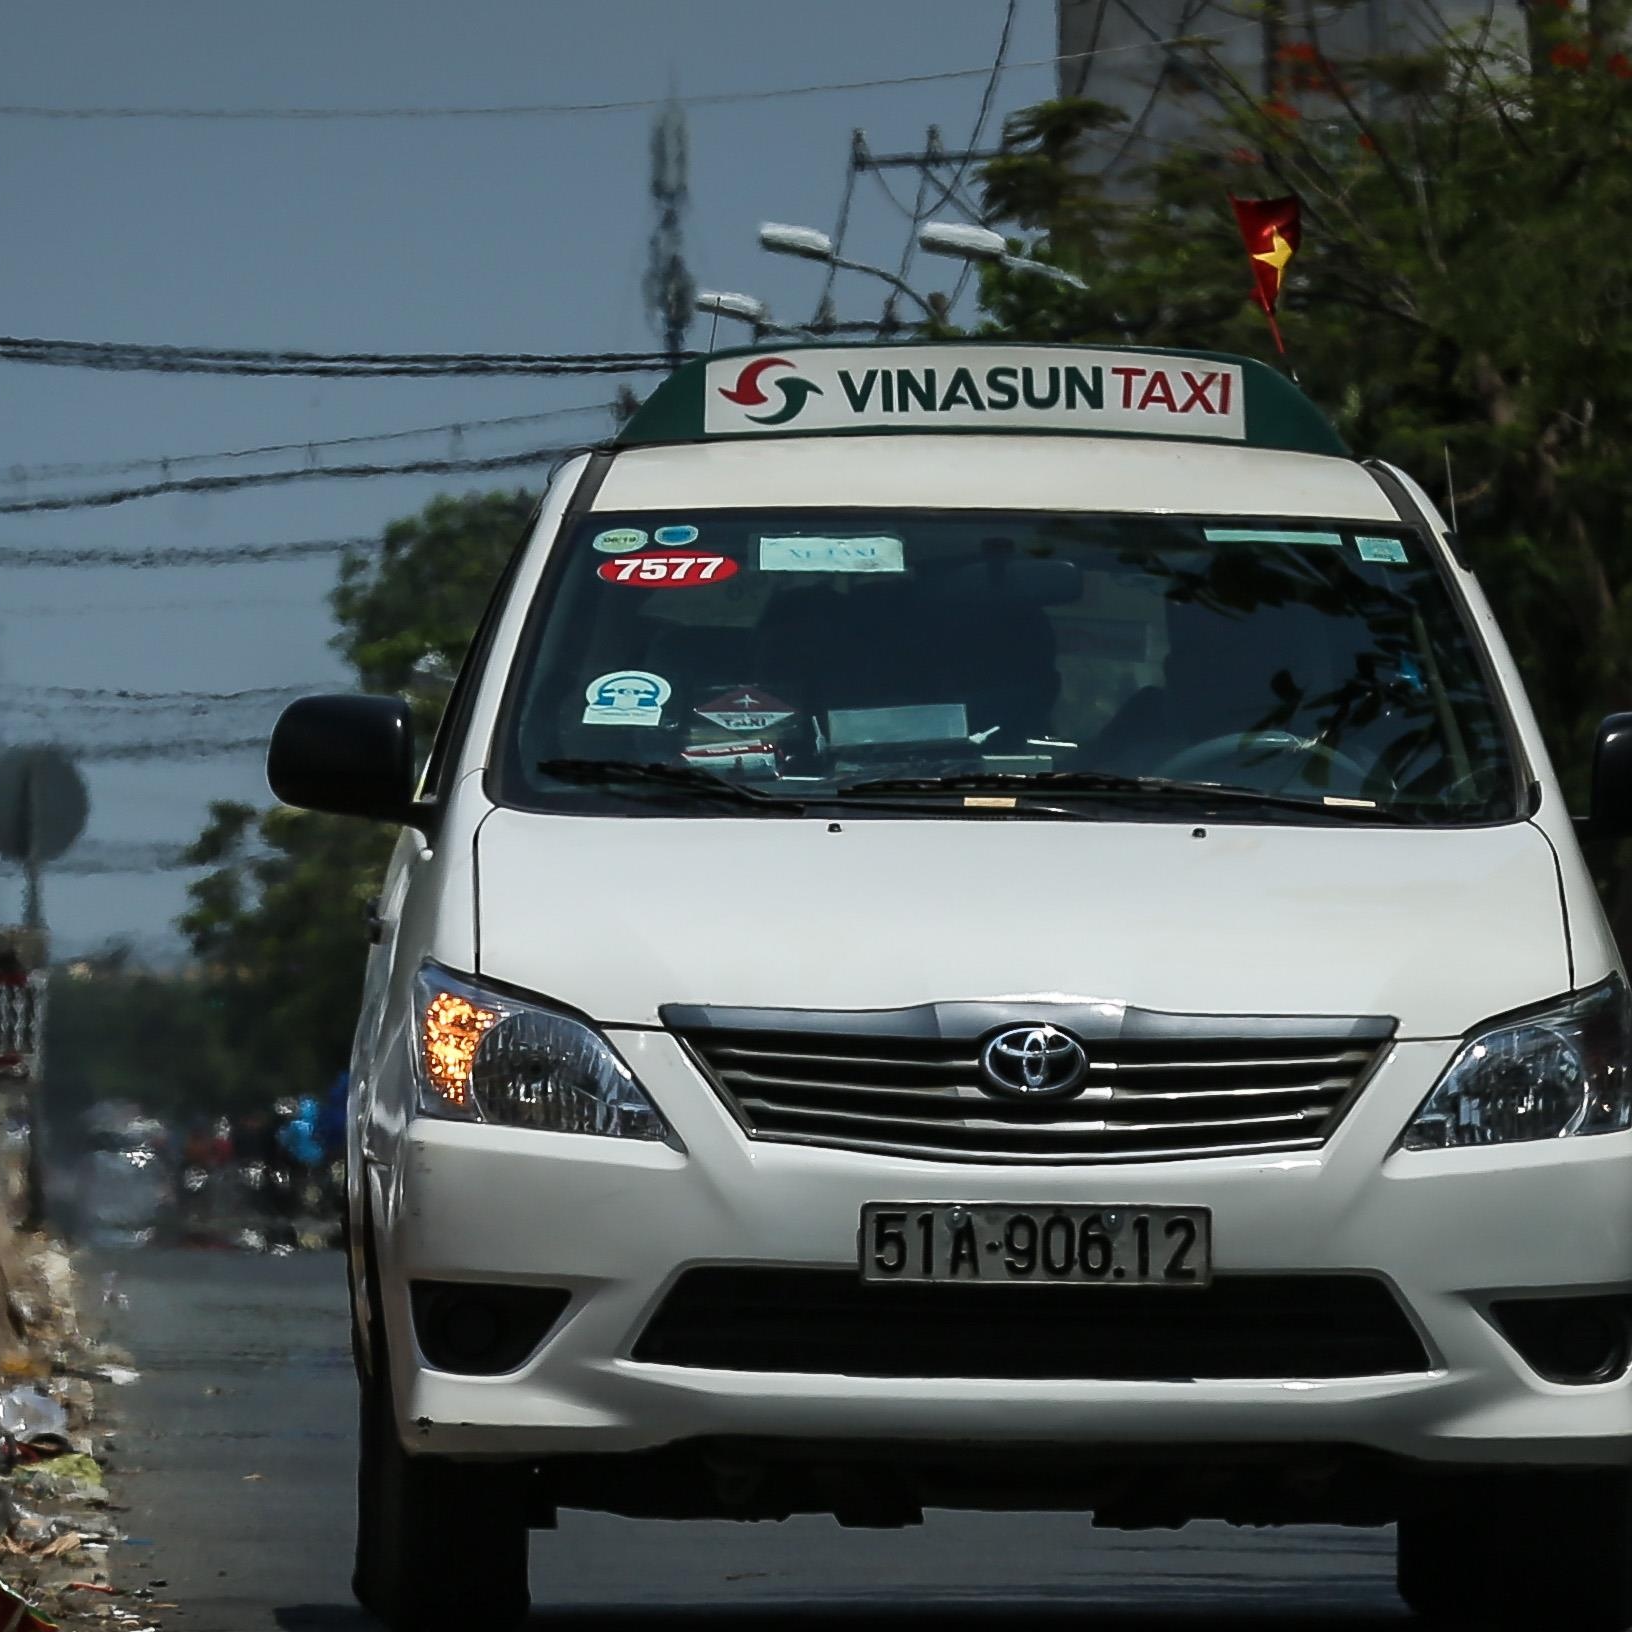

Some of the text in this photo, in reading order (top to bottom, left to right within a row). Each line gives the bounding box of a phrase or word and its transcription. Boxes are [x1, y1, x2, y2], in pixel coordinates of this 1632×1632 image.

[837, 366, 1231, 415] VINASUN TAXI
[614, 557, 724, 581] 7577
[873, 1211, 1197, 1279] 51A-906.12
